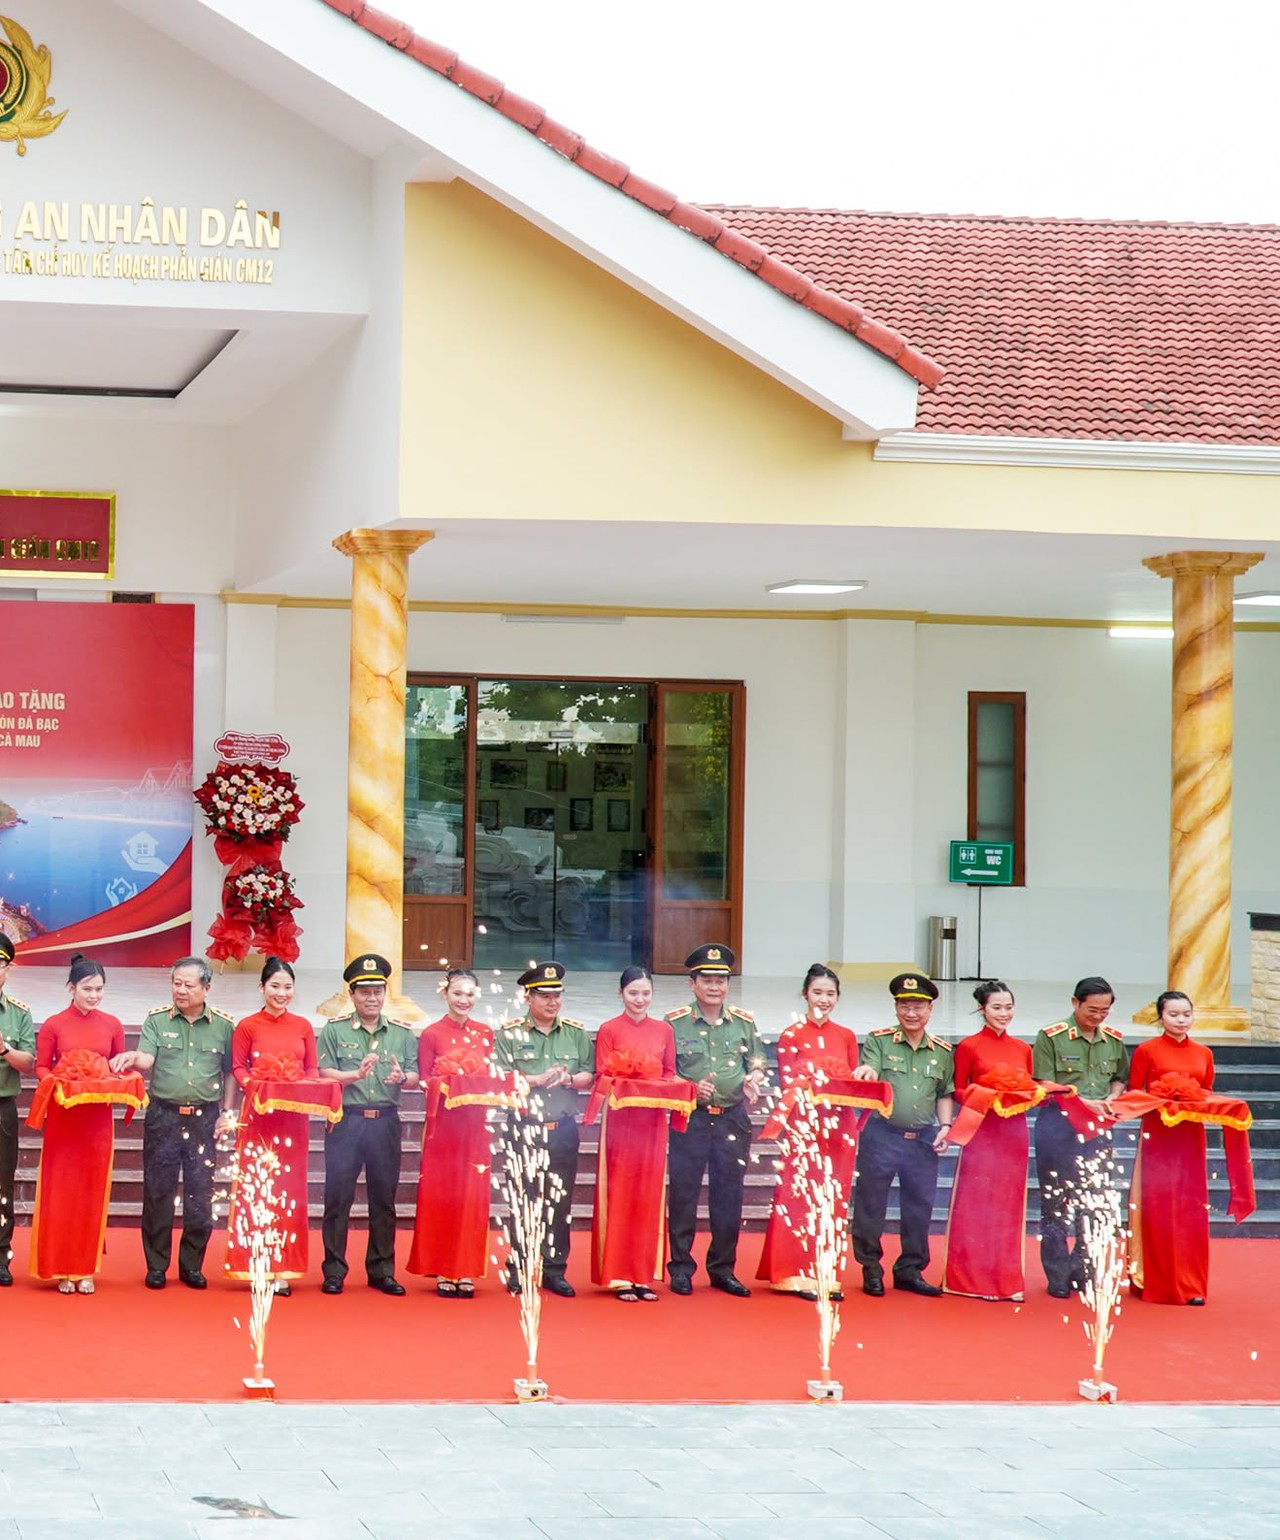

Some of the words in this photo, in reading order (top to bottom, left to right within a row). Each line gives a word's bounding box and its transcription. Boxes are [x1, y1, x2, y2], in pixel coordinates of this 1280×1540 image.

[14, 201, 70, 242] AN
[80, 196, 189, 246] NHÂN
[200, 199, 281, 249] DÂN
[36, 243, 58, 276] CHỈ
[61, 252, 88, 278] HUY
[92, 244, 114, 278] KẾ
[114, 254, 159, 285] HOẠCH
[160, 247, 197, 281] PHẢN
[199, 252, 233, 283] GIÁN
[236, 257, 274, 285] CM12
[19, 689, 66, 713] TẶNG
[17, 715, 34, 730] ĐÁ
[36, 717, 60, 733] BẠC
[15, 735, 41, 748] MAU
[986, 855, 1002, 866] WC
